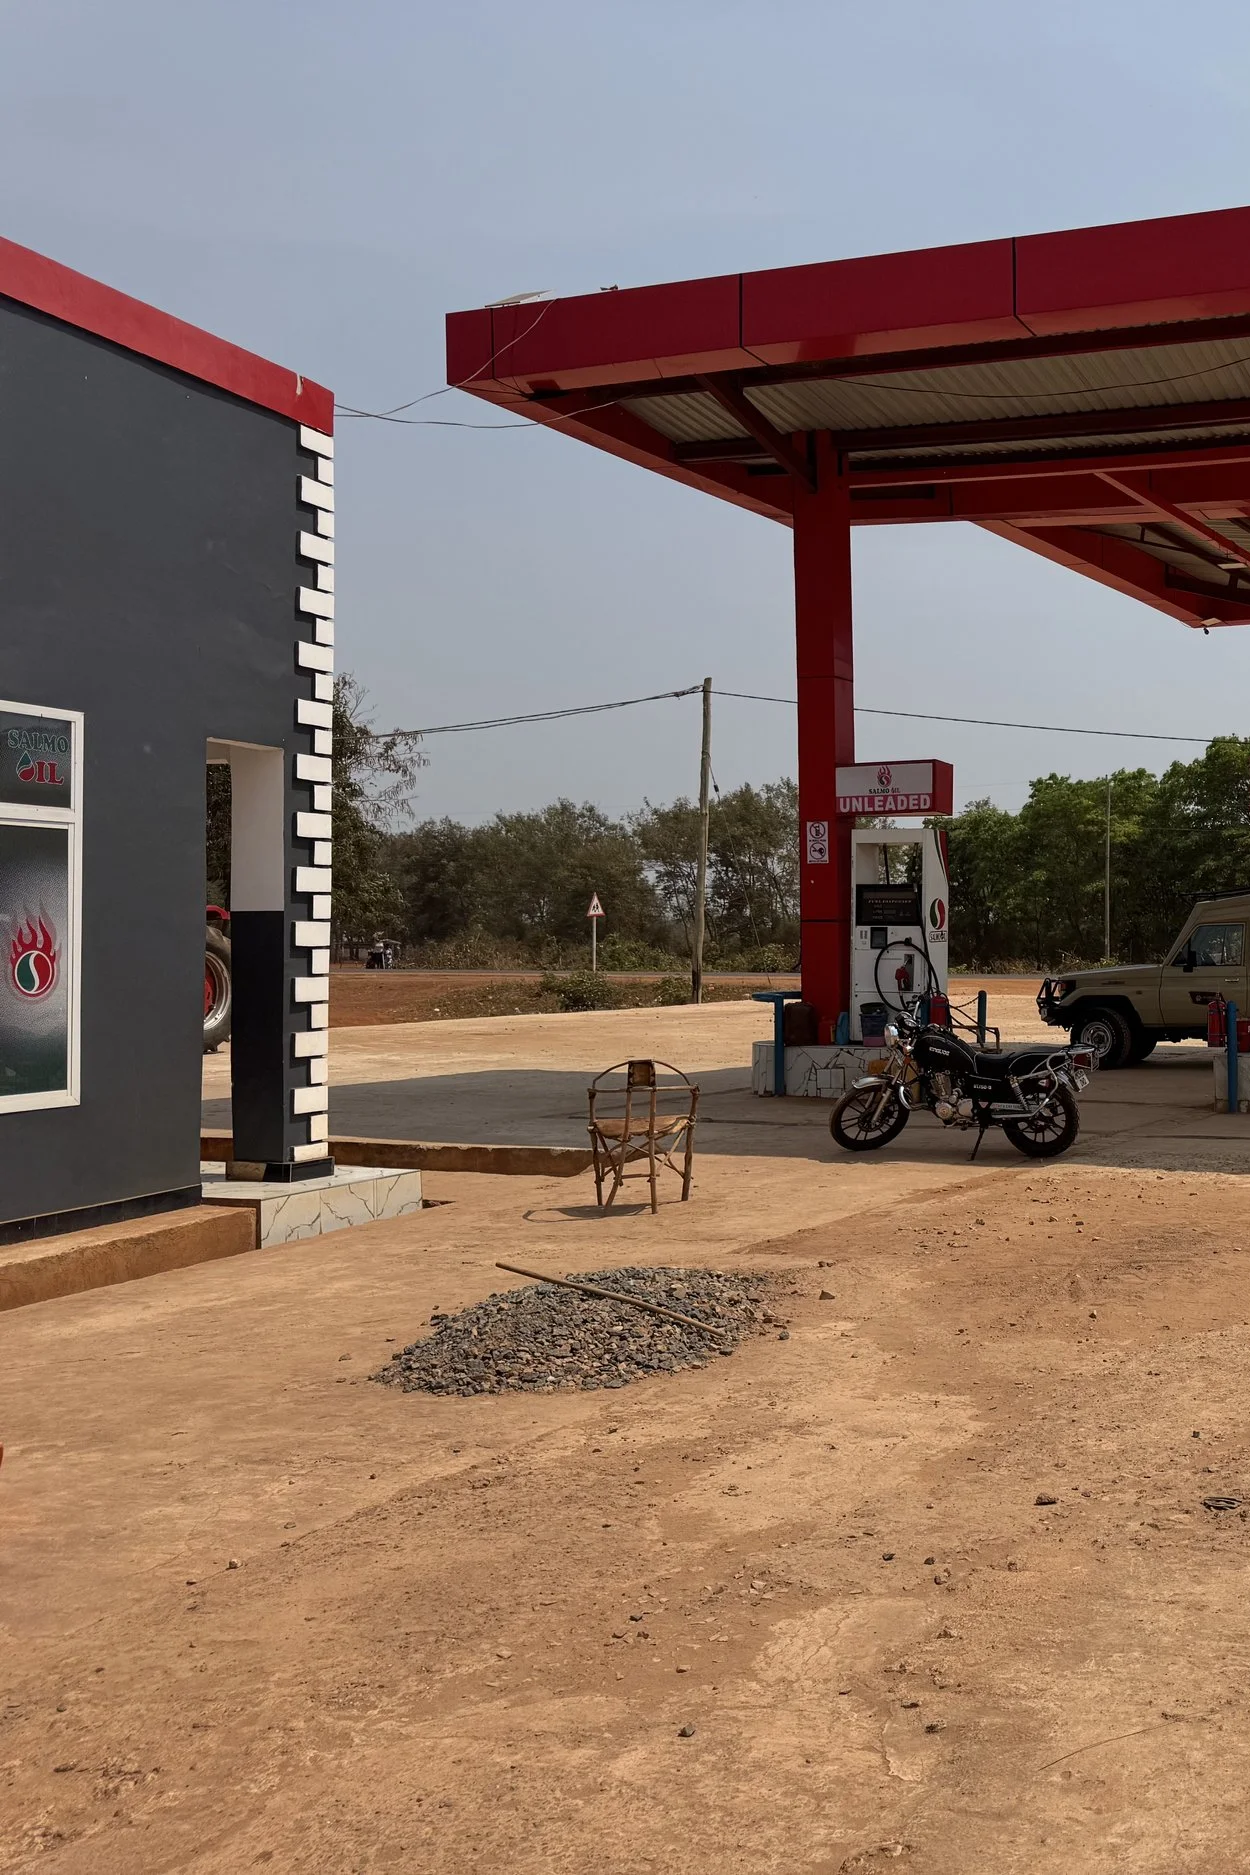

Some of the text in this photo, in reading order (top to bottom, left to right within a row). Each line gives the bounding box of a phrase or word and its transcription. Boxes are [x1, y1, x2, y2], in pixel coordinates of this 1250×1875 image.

[7, 729, 69, 754] SALMO
[16, 750, 64, 785] OIL
[840, 794, 931, 813] UNLEADED
